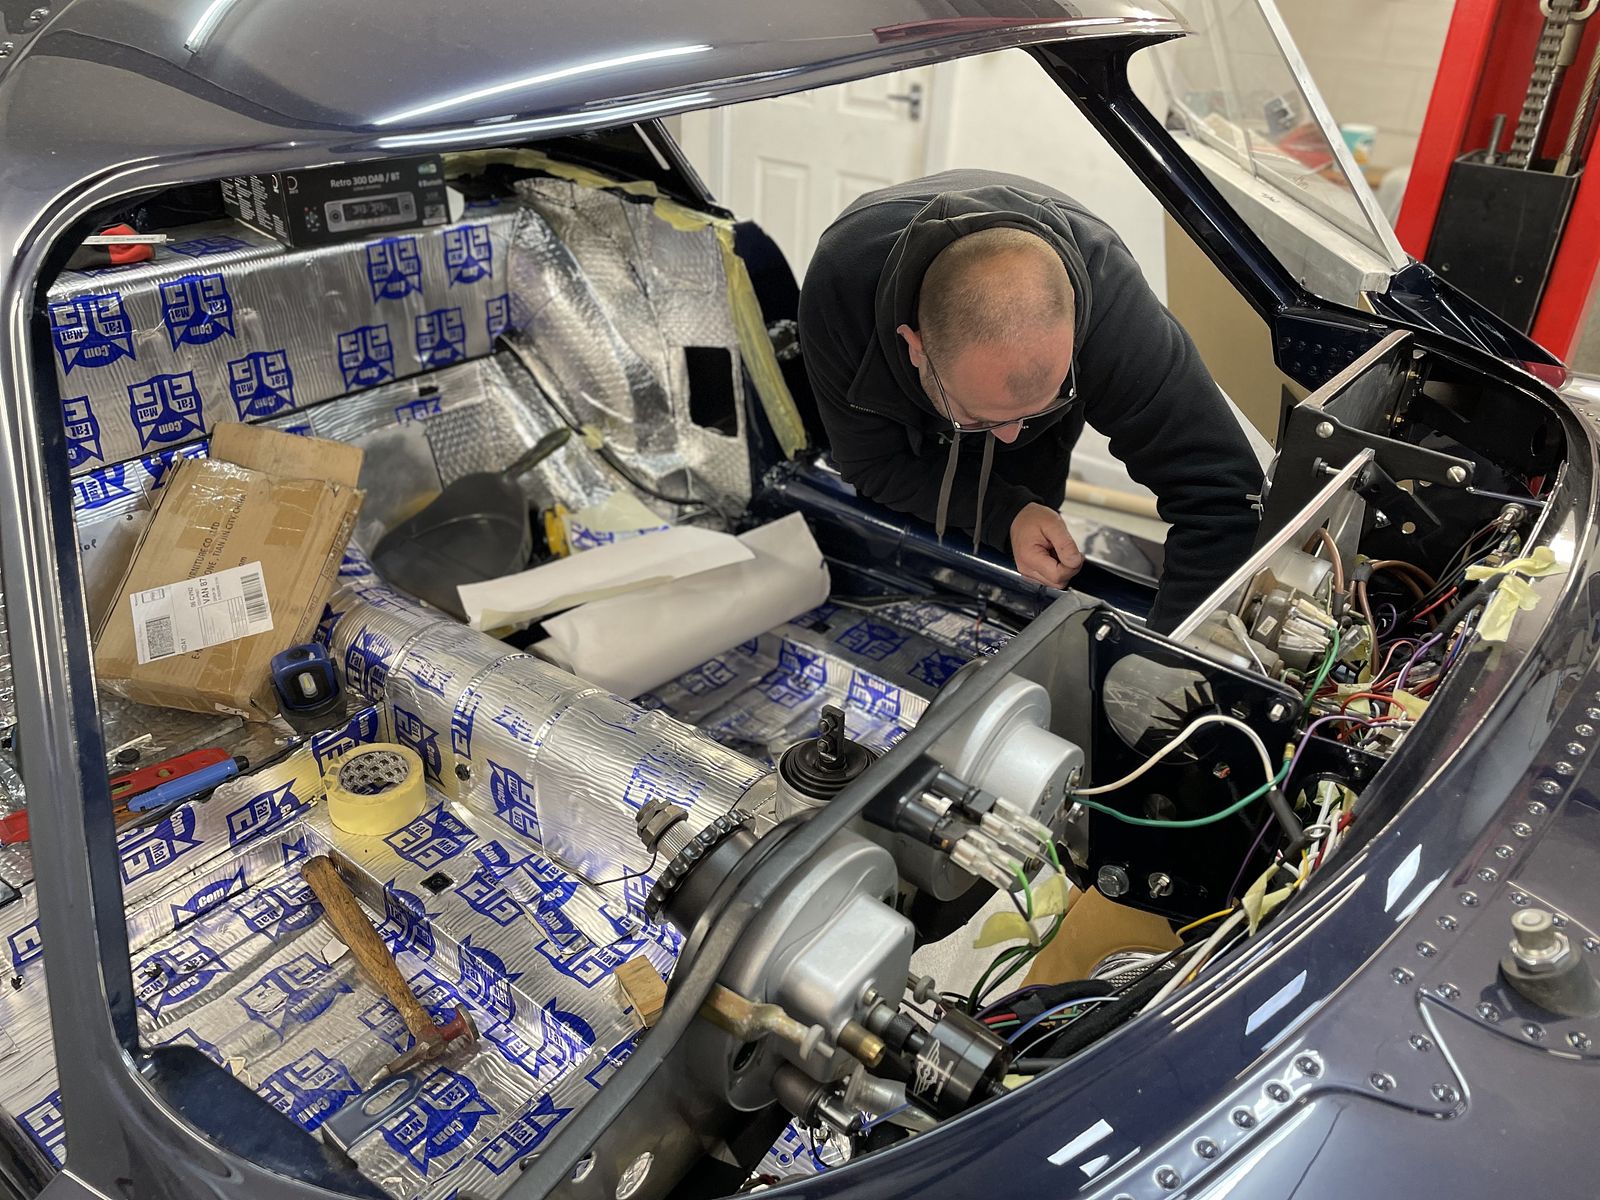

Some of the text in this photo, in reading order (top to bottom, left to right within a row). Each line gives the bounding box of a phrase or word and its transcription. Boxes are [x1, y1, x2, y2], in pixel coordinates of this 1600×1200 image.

[330, 178, 352, 189] Retro
[352, 175, 368, 186] 300
[368, 172, 385, 184] DAB
[390, 170, 400, 181] BT
[169, 301, 226, 322] Fat Mat
[62, 321, 123, 343] Fat Mat
[83, 344, 111, 358] .Com
[237, 374, 287, 394] Fat Mat
[139, 398, 195, 420] Fat Mat
[70, 423, 90, 437] Fat
[158, 419, 183, 434] .Com
[212, 541, 225, 557] TIAN
[200, 578, 210, 604] VAN 87
[350, 653, 363, 667] Fat
[410, 721, 420, 739] Fat
[256, 801, 268, 822] Fat
[507, 777, 523, 828] Fat Mat
[413, 823, 456, 852] Fat Mat
[152, 840, 169, 864] Mat
[196, 887, 224, 910] .Com
[256, 910, 281, 926] Mat
[595, 948, 618, 967] Mat
[168, 973, 201, 997] .Com
[306, 1068, 337, 1086] Fat
[396, 1084, 467, 1141] Fat Mat
[507, 1122, 534, 1144] Mat
